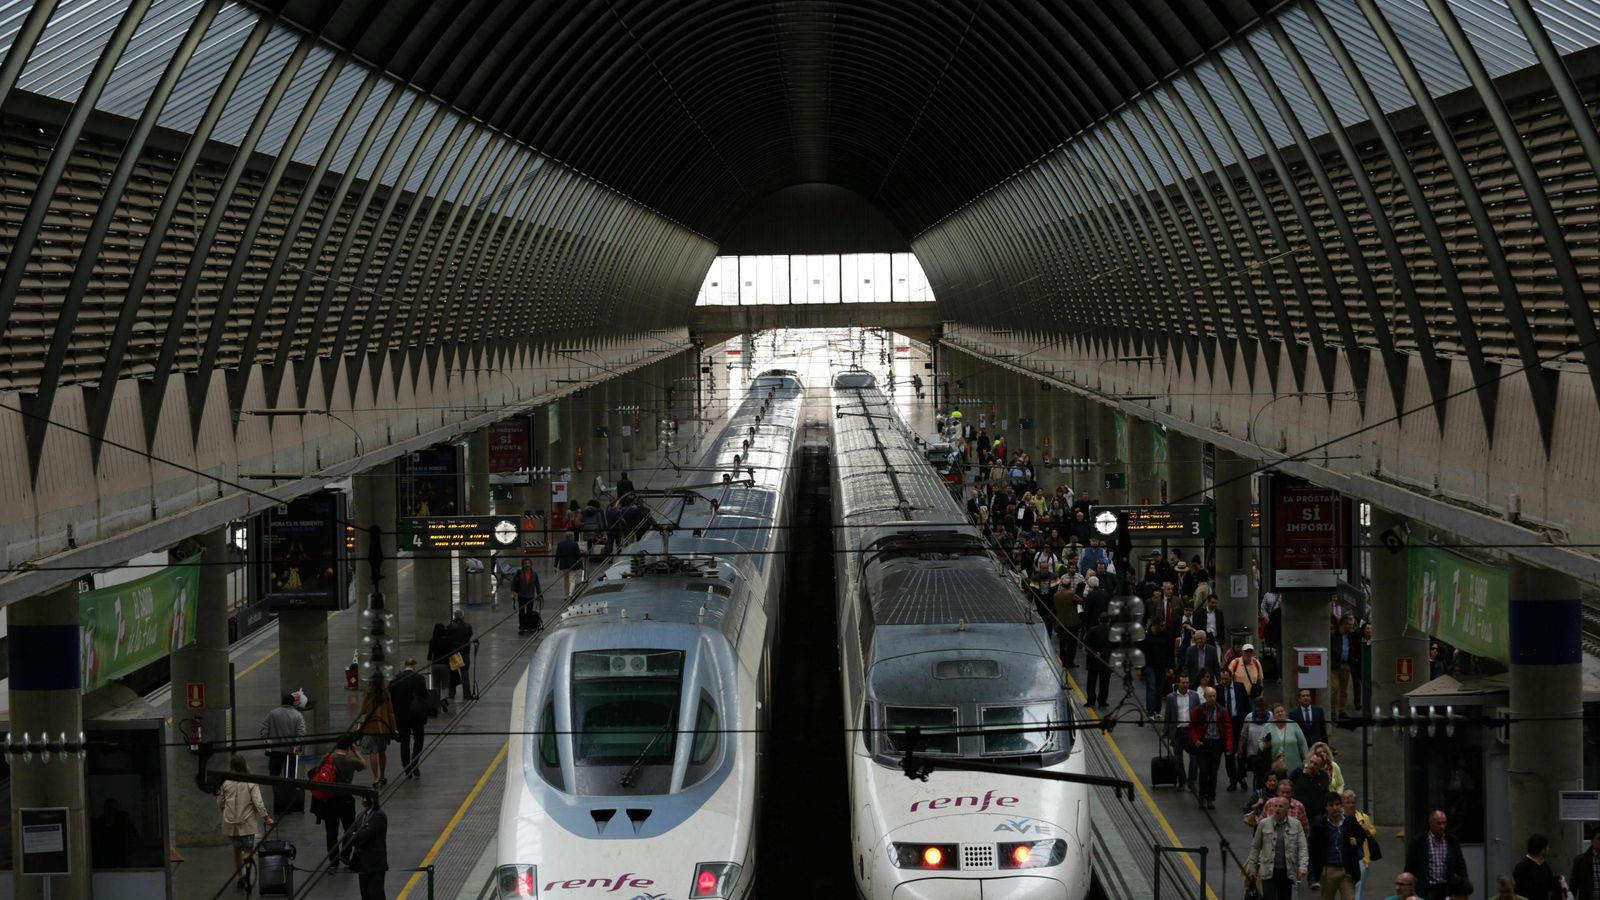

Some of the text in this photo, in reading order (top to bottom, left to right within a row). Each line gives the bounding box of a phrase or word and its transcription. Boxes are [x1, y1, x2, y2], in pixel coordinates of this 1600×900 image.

[1105, 480, 1111, 489] 3
[1302, 504, 1321, 521] SÍ
[1191, 521, 1201, 535] 3
[1287, 523, 1337, 532] IMPORTA
[412, 534, 423, 547] 4
[910, 789, 1020, 813] renfe
[993, 818, 1052, 835] AVE
[543, 872, 655, 892] renfe
